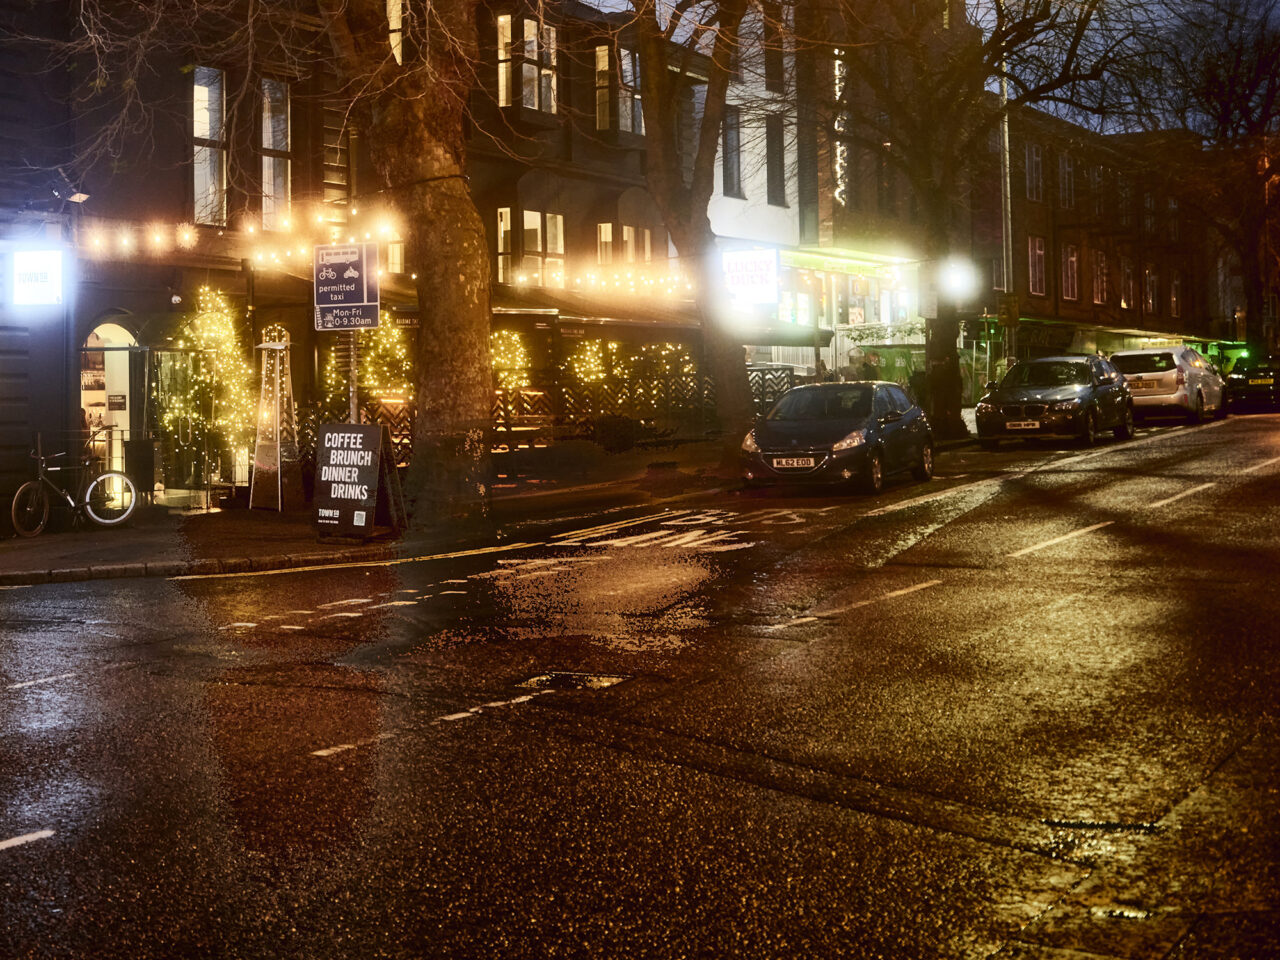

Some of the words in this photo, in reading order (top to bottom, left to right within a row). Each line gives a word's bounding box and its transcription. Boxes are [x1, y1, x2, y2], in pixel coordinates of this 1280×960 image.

[319, 284, 356, 293] permitted
[330, 293, 345, 301] taxi
[333, 308, 362, 317] Mon-Fri
[325, 432, 364, 449] COFFEE
[330, 449, 372, 466] BRUNCH
[321, 465, 359, 482] DINNER
[331, 482, 369, 500] DRINKS
